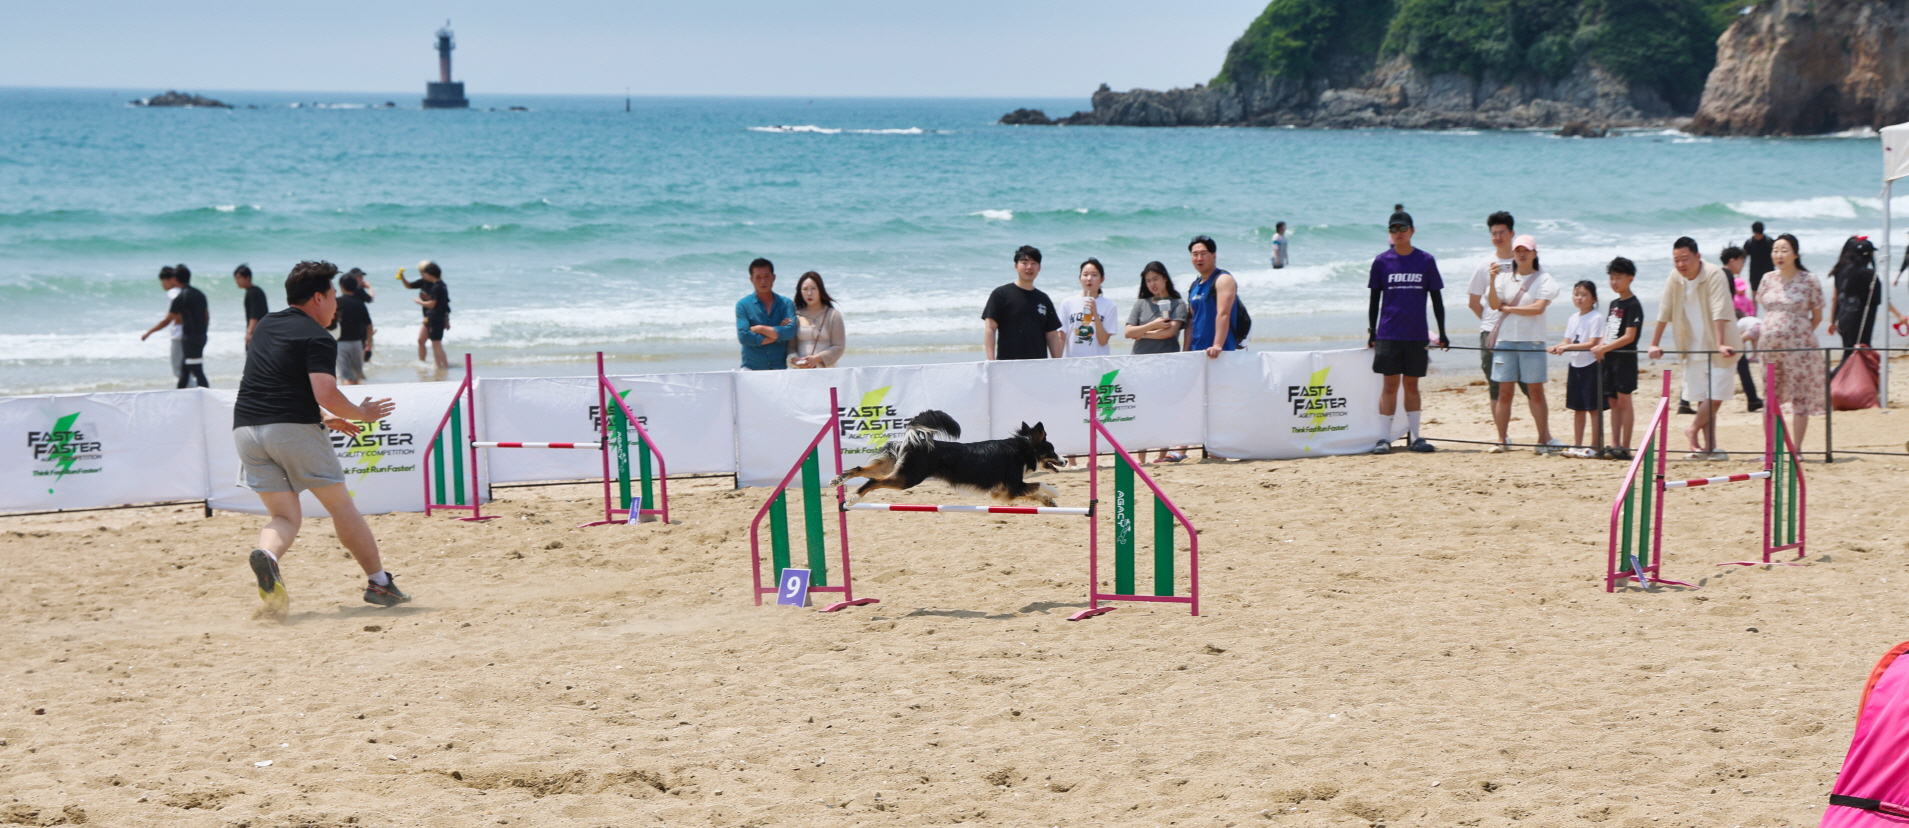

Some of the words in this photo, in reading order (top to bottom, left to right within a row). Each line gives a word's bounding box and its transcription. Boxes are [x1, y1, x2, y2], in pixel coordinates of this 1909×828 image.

[1388, 273, 1423, 283] FOCUS
[1081, 385, 1113, 399] FST
[1114, 384, 1123, 393] &
[1288, 386, 1325, 402] FAST
[1326, 385, 1333, 396] &
[885, 405, 897, 416] &
[1293, 398, 1347, 415] FASTER
[380, 420, 391, 431] &
[28, 431, 72, 447] FAST
[74, 430, 84, 440] &
[34, 442, 102, 459] FASTER
[366, 449, 415, 457] COMPETITION
[387, 464, 415, 472] Faster!
[1117, 490, 1125, 528] AGACY
[786, 576, 801, 598] 9
